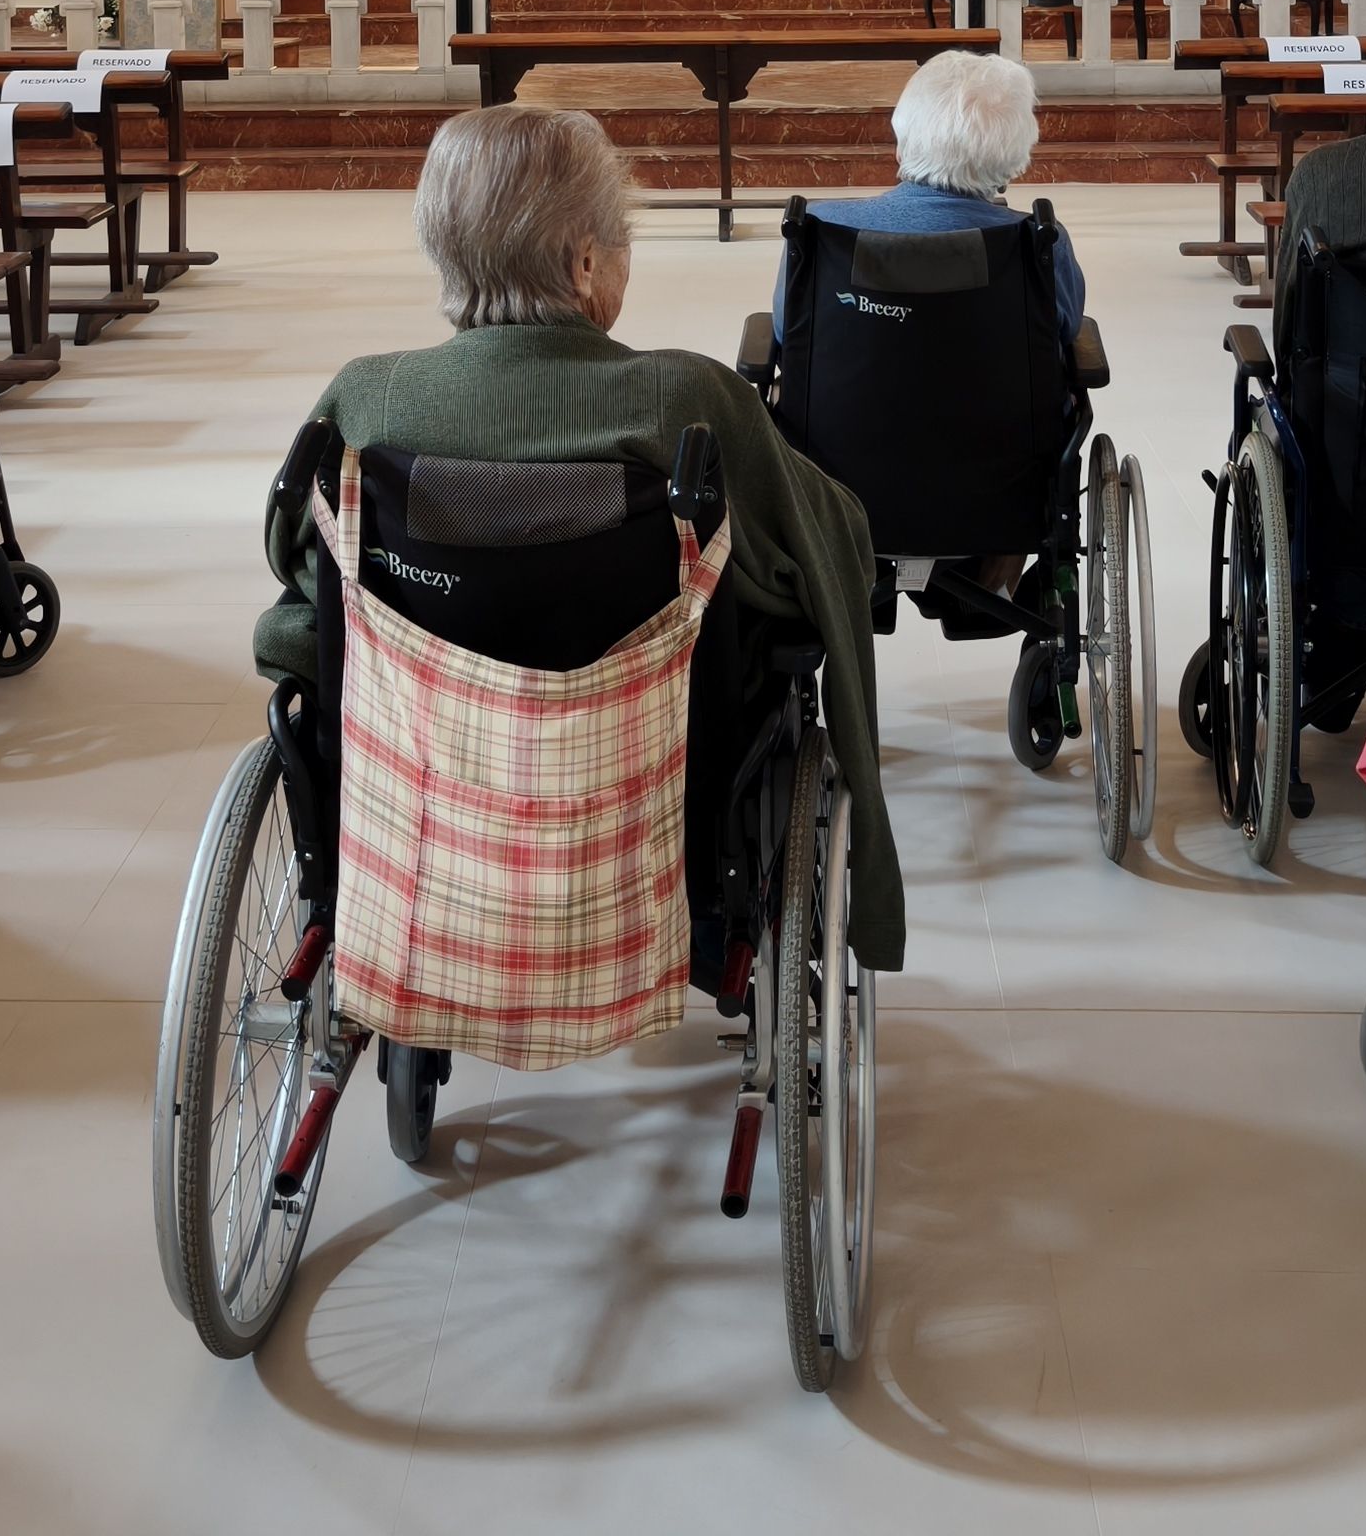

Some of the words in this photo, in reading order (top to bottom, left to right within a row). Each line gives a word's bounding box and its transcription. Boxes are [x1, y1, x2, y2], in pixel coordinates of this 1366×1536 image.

[1283, 44, 1346, 53] RESERVADO
[92, 58, 152, 67] RESERVADO
[19, 77, 87, 85] RESERVADO
